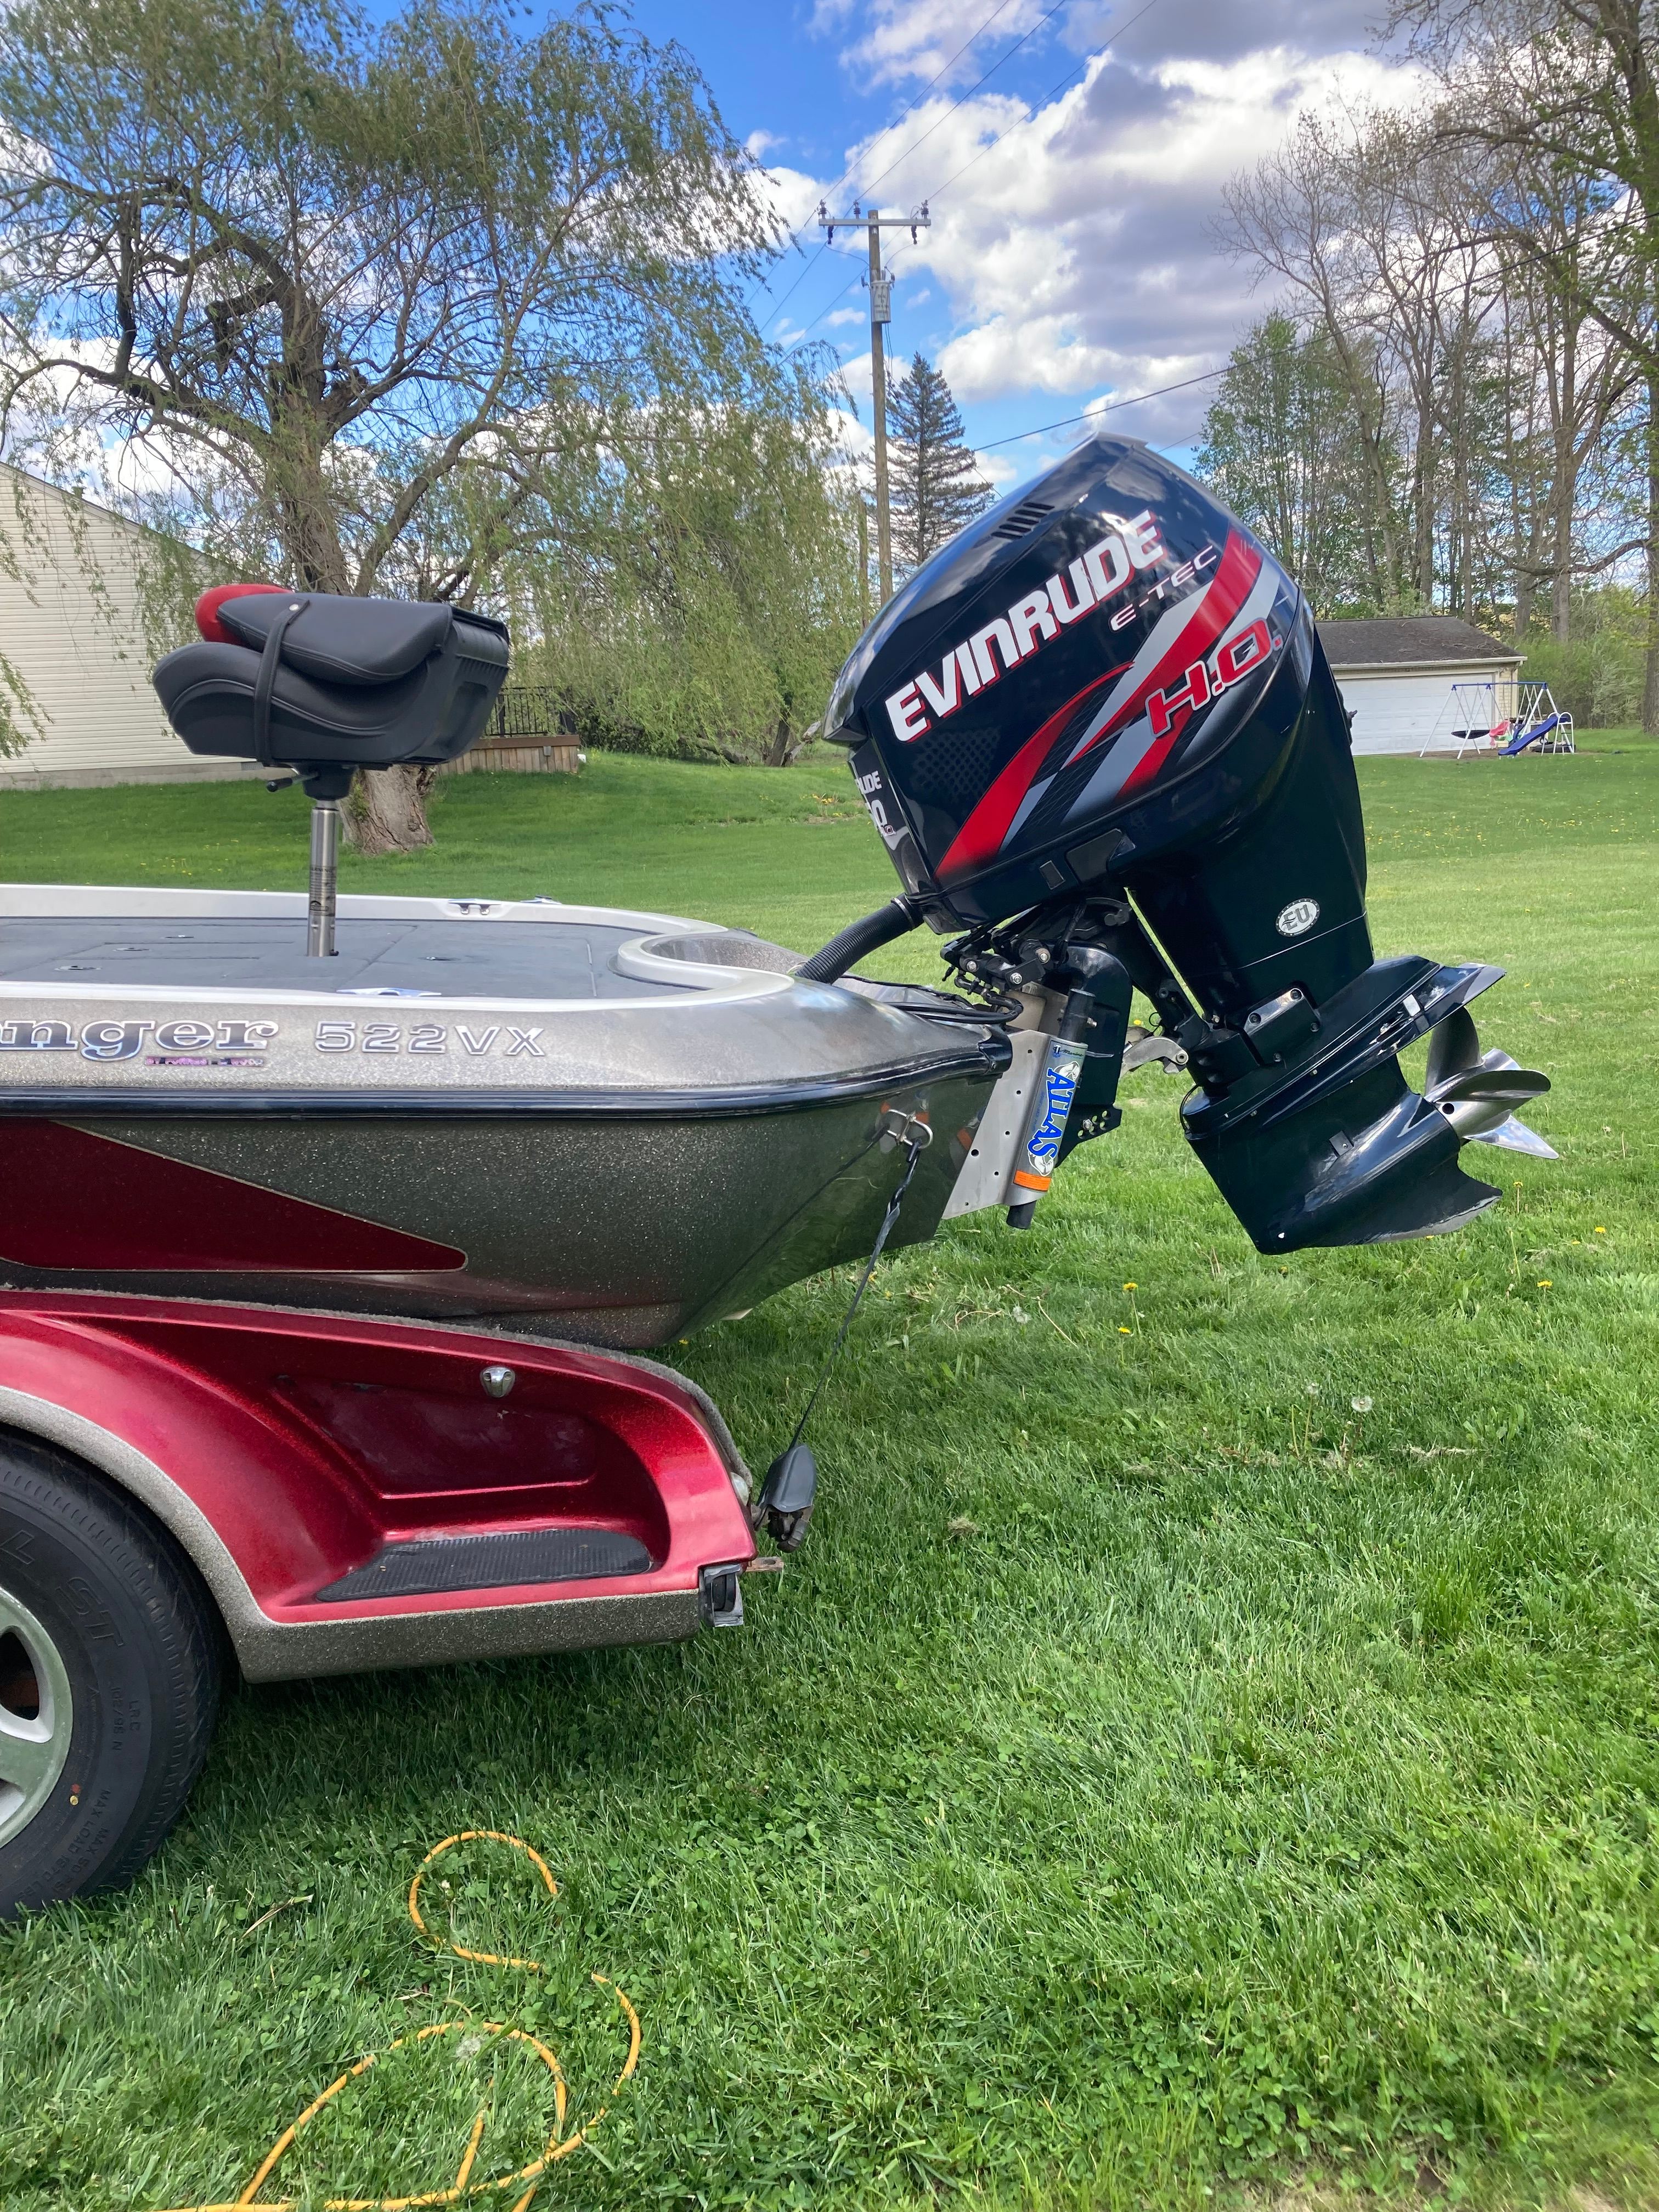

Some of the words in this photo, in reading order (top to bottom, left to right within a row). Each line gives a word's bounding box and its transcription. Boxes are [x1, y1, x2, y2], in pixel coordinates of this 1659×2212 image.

[885, 510, 1167, 742] EVINRUDE
[1110, 545, 1217, 631] E-TEC
[1145, 618, 1283, 738] H.O.
[0, 1020, 279, 1062] nger
[1027, 1068, 1076, 1158] ATLAS
